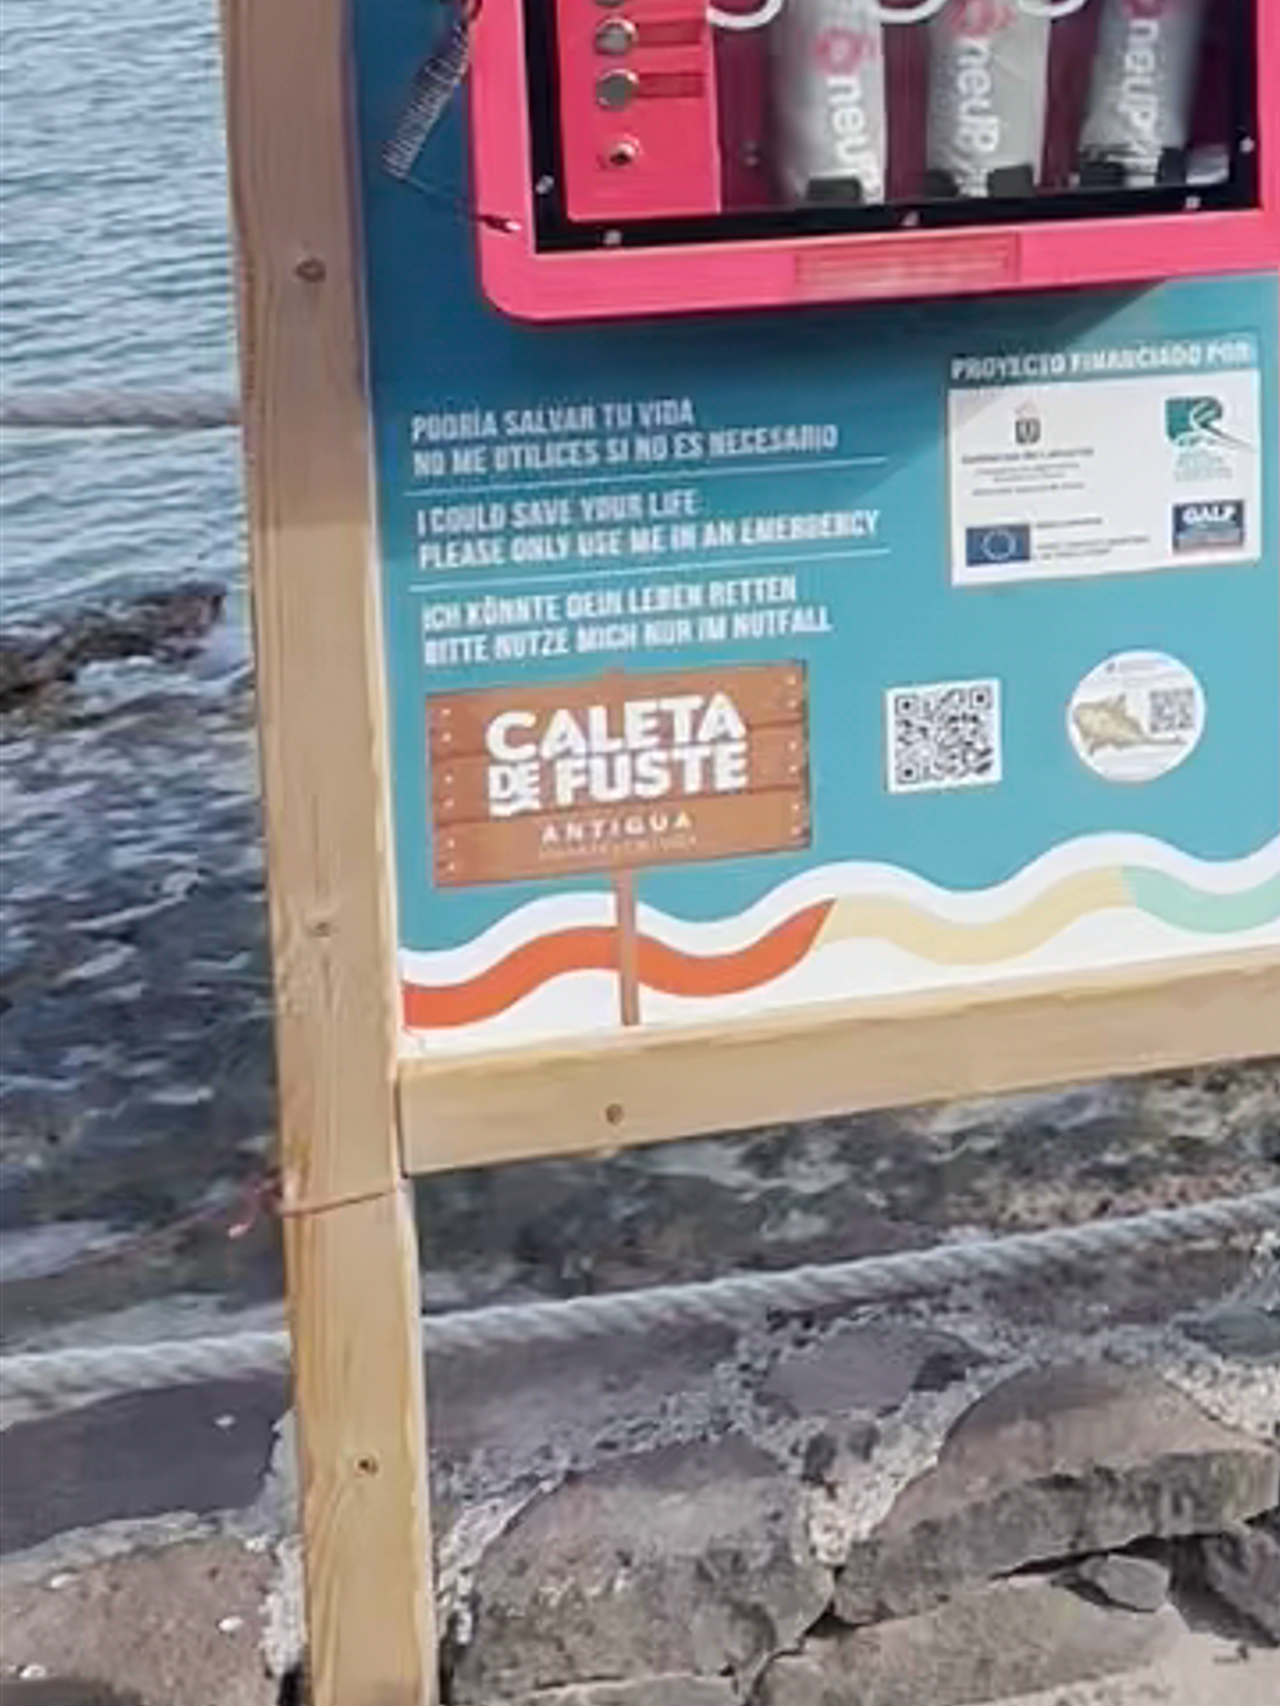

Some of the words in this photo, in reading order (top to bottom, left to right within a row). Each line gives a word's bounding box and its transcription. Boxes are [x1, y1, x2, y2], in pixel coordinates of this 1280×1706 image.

[504, 404, 595, 438] SALVAR
[638, 397, 695, 429] VIDA
[413, 448, 445, 477] NO
[452, 444, 489, 475] ME
[495, 438, 600, 472] UTILICES
[605, 435, 630, 464] SI
[635, 434, 669, 462] NO
[673, 431, 706, 459] ES
[710, 424, 839, 458] NECESARIO
[431, 503, 504, 535] COULD
[510, 498, 571, 530] SAVE
[580, 492, 643, 524] YOUR
[648, 489, 699, 518] LIFE
[419, 535, 505, 572] PLEASE
[510, 531, 570, 563] ONLY
[578, 526, 624, 558] USE
[631, 523, 665, 554] ME
[671, 521, 697, 551] IN
[703, 518, 735, 549] AN
[741, 509, 881, 545] EMERGENCY
[422, 602, 463, 632] ICH
[629, 582, 703, 614] LEBEN
[709, 574, 798, 609] RETTEN
[423, 633, 490, 667] BITTE
[575, 622, 639, 655] MICH
[644, 617, 694, 648] NUR
[698, 614, 728, 644] IM
[485, 691, 748, 762] CALETA
[488, 761, 541, 802] DE
[554, 741, 748, 807] FUSTE
[541, 811, 692, 845] ANTIGUA
